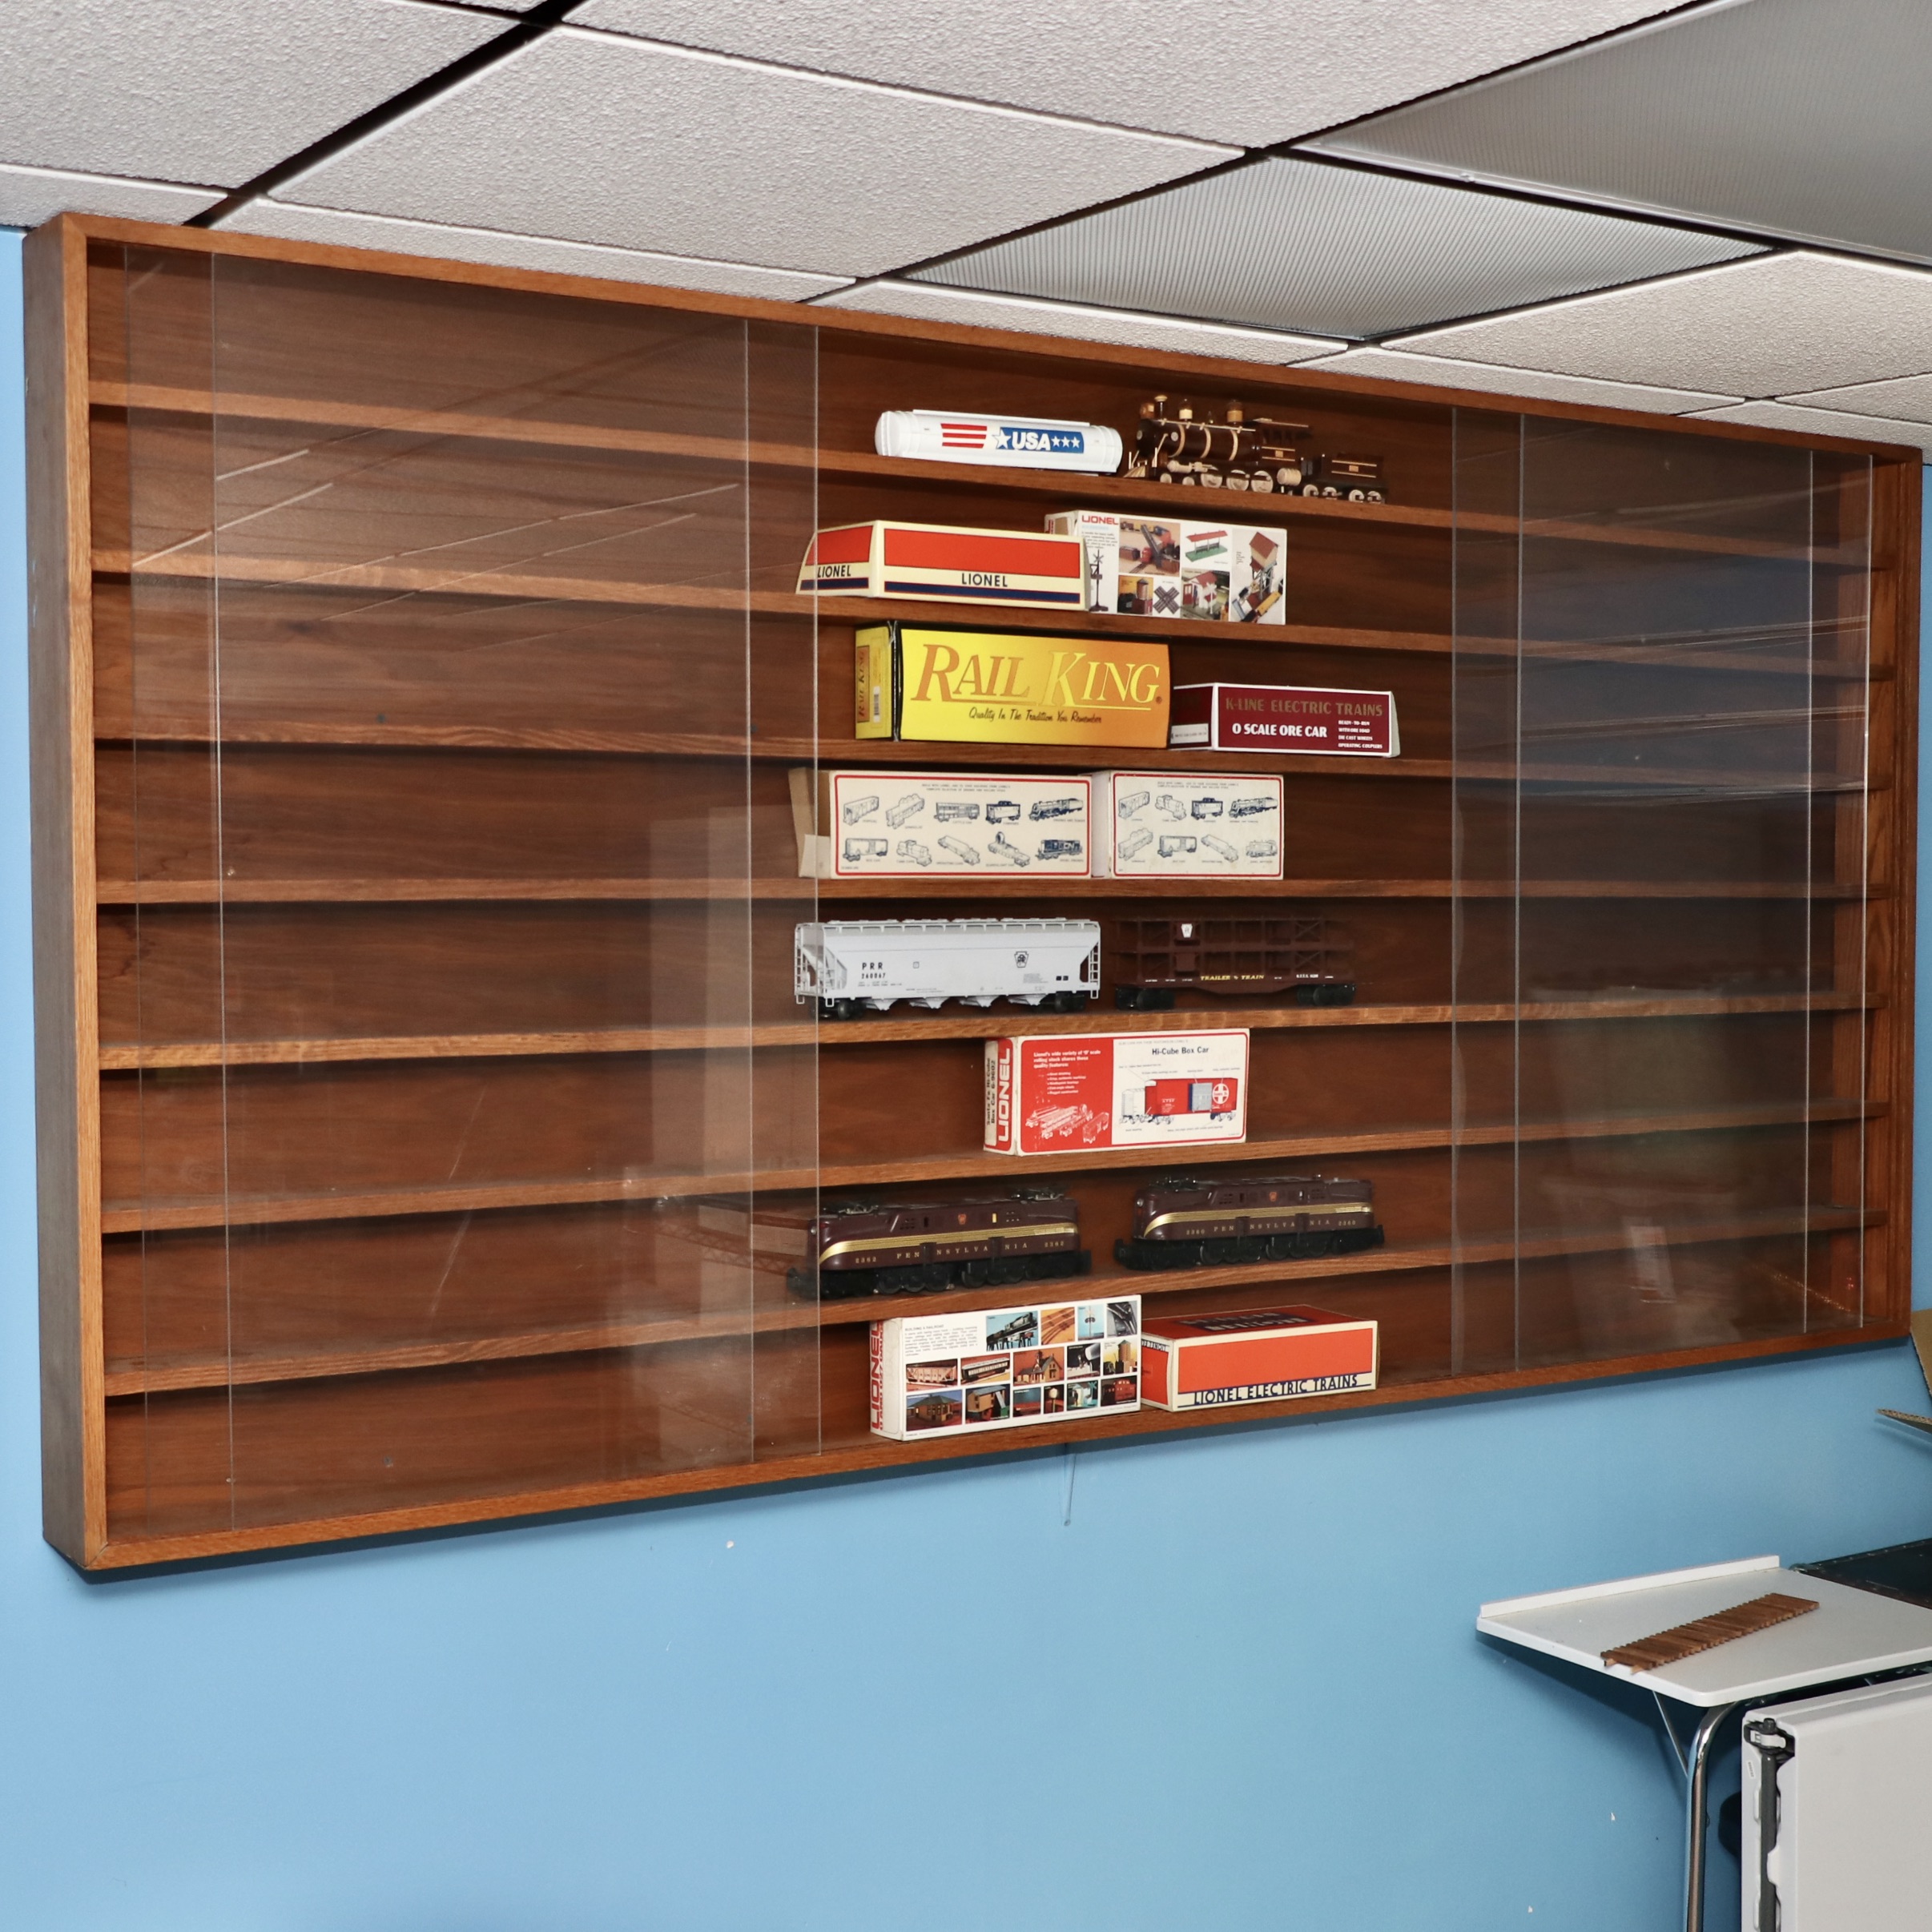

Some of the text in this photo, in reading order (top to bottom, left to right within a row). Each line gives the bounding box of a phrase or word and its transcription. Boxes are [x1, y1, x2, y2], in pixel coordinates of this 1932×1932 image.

[1012, 432, 1051, 451] USA
[1081, 515, 1119, 525] LIONEL
[817, 565, 851, 578] LIONEL
[961, 573, 1008, 587] LIONEL
[911, 643, 1161, 707] RAIL KING
[969, 706, 1102, 723] Quality In The Tradition You Remember
[1226, 698, 1383, 716] K-LINE ELECTRIC TRAINS
[1232, 723, 1327, 738] O SCALE ORE CAR
[862, 962, 883, 970] PRR
[998, 1048, 1011, 1141] LIONEL
[871, 1320, 879, 1430] LIONEL
[1194, 1375, 1358, 1405] LIONEL ELECTRIC TRAINS
